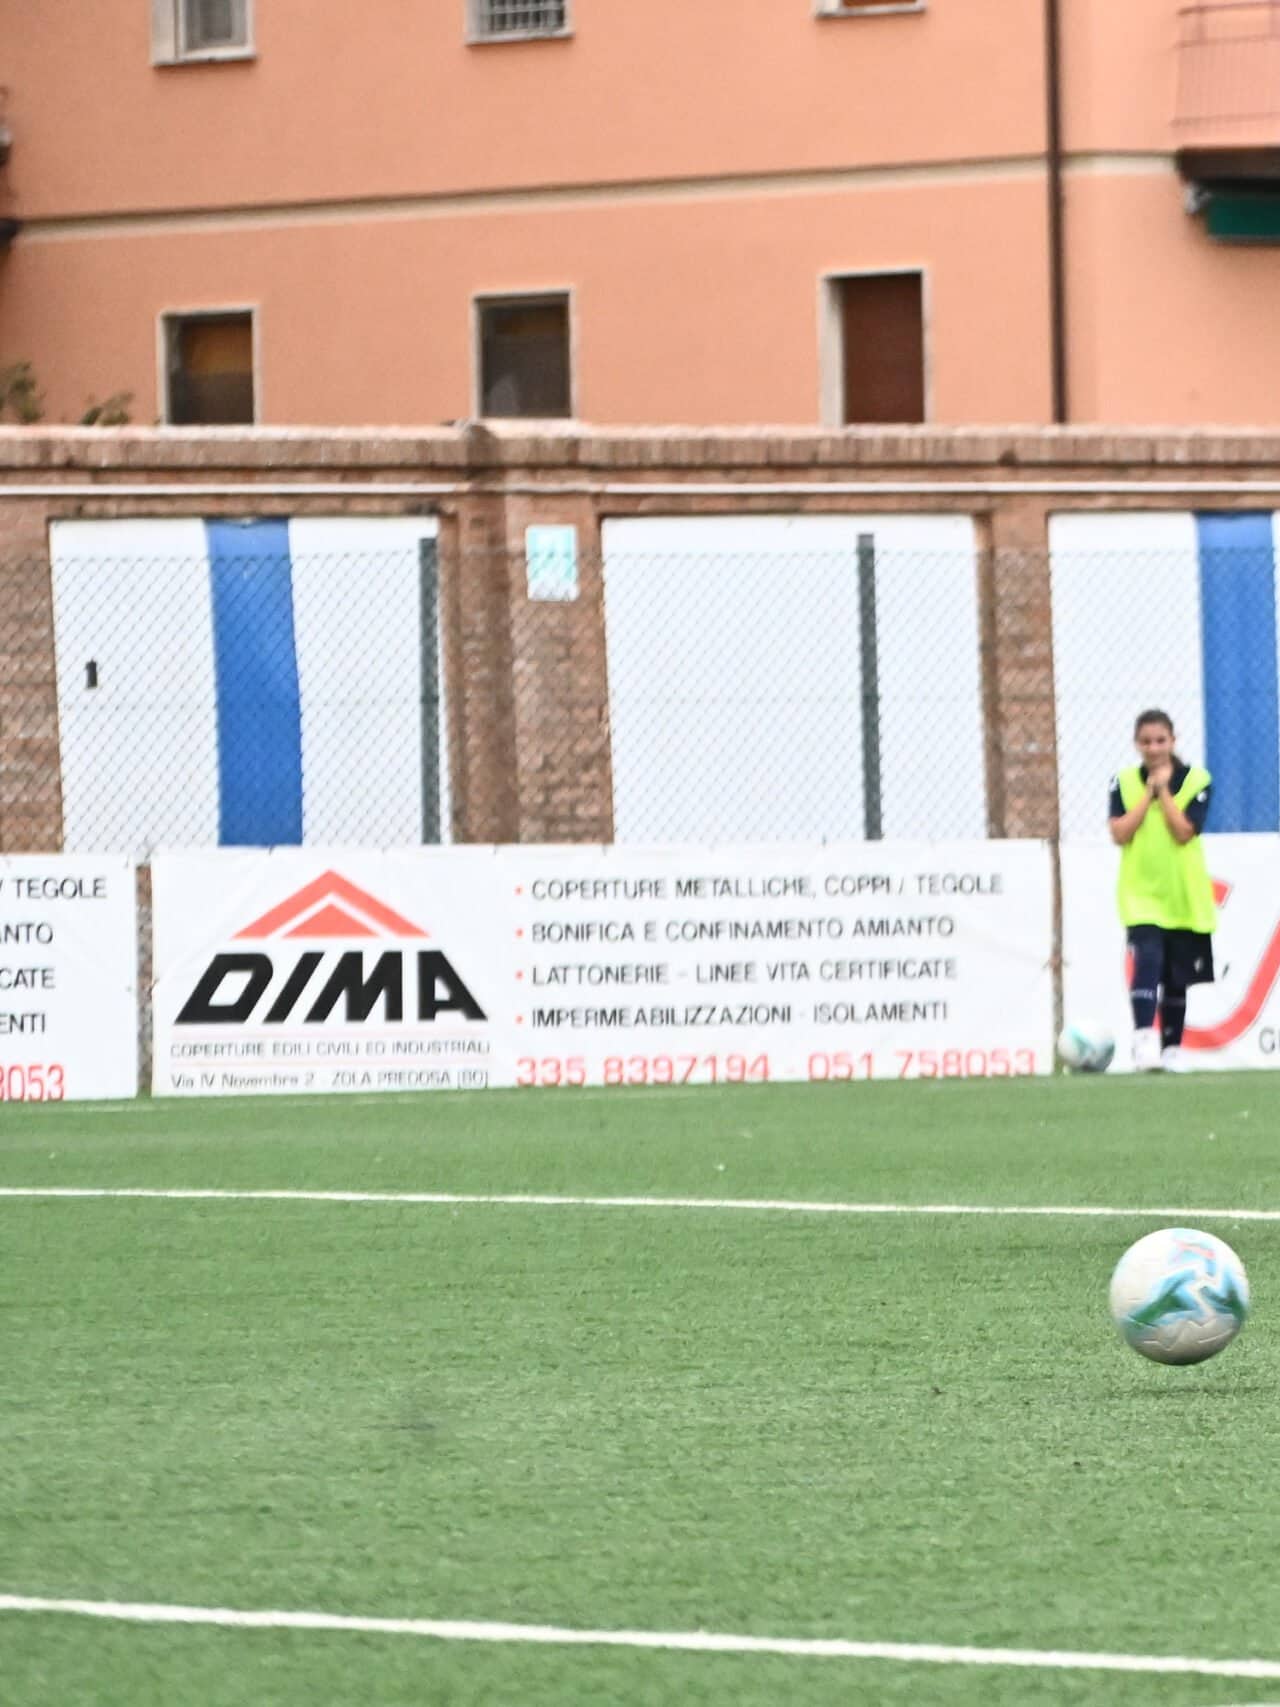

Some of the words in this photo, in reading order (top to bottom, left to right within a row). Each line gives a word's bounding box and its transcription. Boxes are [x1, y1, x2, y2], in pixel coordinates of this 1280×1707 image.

[15, 877, 106, 900] TEGOLE
[531, 878, 666, 900] COPERTURE
[675, 875, 817, 899] METALLICHE,
[825, 873, 891, 896] COPPI
[917, 873, 1003, 895] TEGOLE
[0, 922, 54, 945] NTO
[531, 920, 635, 942] BONIFICA
[643, 919, 657, 941] E
[665, 916, 844, 941] CONFINAMENTO
[852, 915, 955, 937] AMIANTO
[531, 963, 669, 985] LATTONERIE
[696, 961, 756, 984] LINEE
[766, 961, 811, 981] VITA
[819, 957, 958, 981] CERTIFICATE
[174, 949, 489, 1025] DIMA
[532, 1004, 792, 1029] IMPERMEABILIZZAZIONI
[813, 1001, 948, 1024] ISOLAMENTI
[171, 1073, 195, 1089] Via
[515, 1056, 586, 1087] 335
[602, 1053, 771, 1084] 8397194
[807, 1052, 874, 1081] 051
[896, 1048, 1038, 1079] 758053
[0, 1064, 65, 1102] 053
